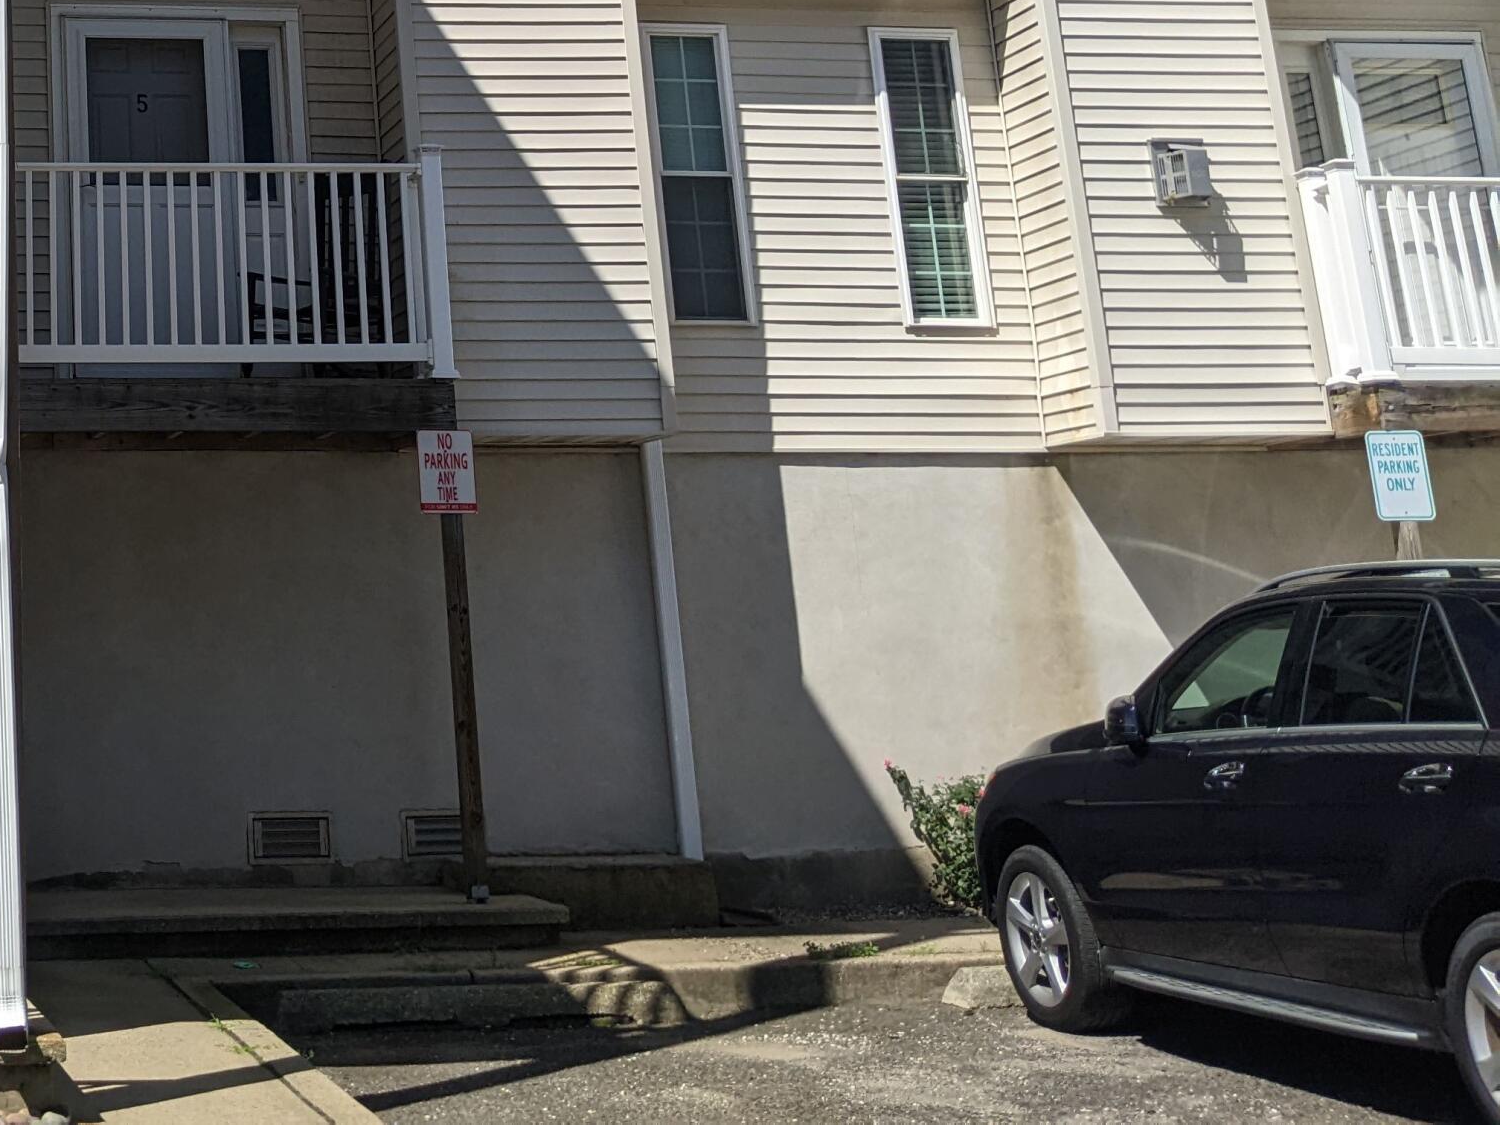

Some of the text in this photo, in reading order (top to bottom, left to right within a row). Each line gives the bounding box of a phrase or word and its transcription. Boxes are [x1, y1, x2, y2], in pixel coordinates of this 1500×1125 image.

[136, 94, 148, 113] 5
[437, 433, 452, 450] NO
[1371, 443, 1420, 457] RESIDENT
[424, 452, 468, 470] PARKING
[1378, 460, 1420, 474] PARKING
[437, 471, 456, 485] ANY
[1386, 478, 1415, 491] ONLY
[437, 486, 458, 502] TIME
